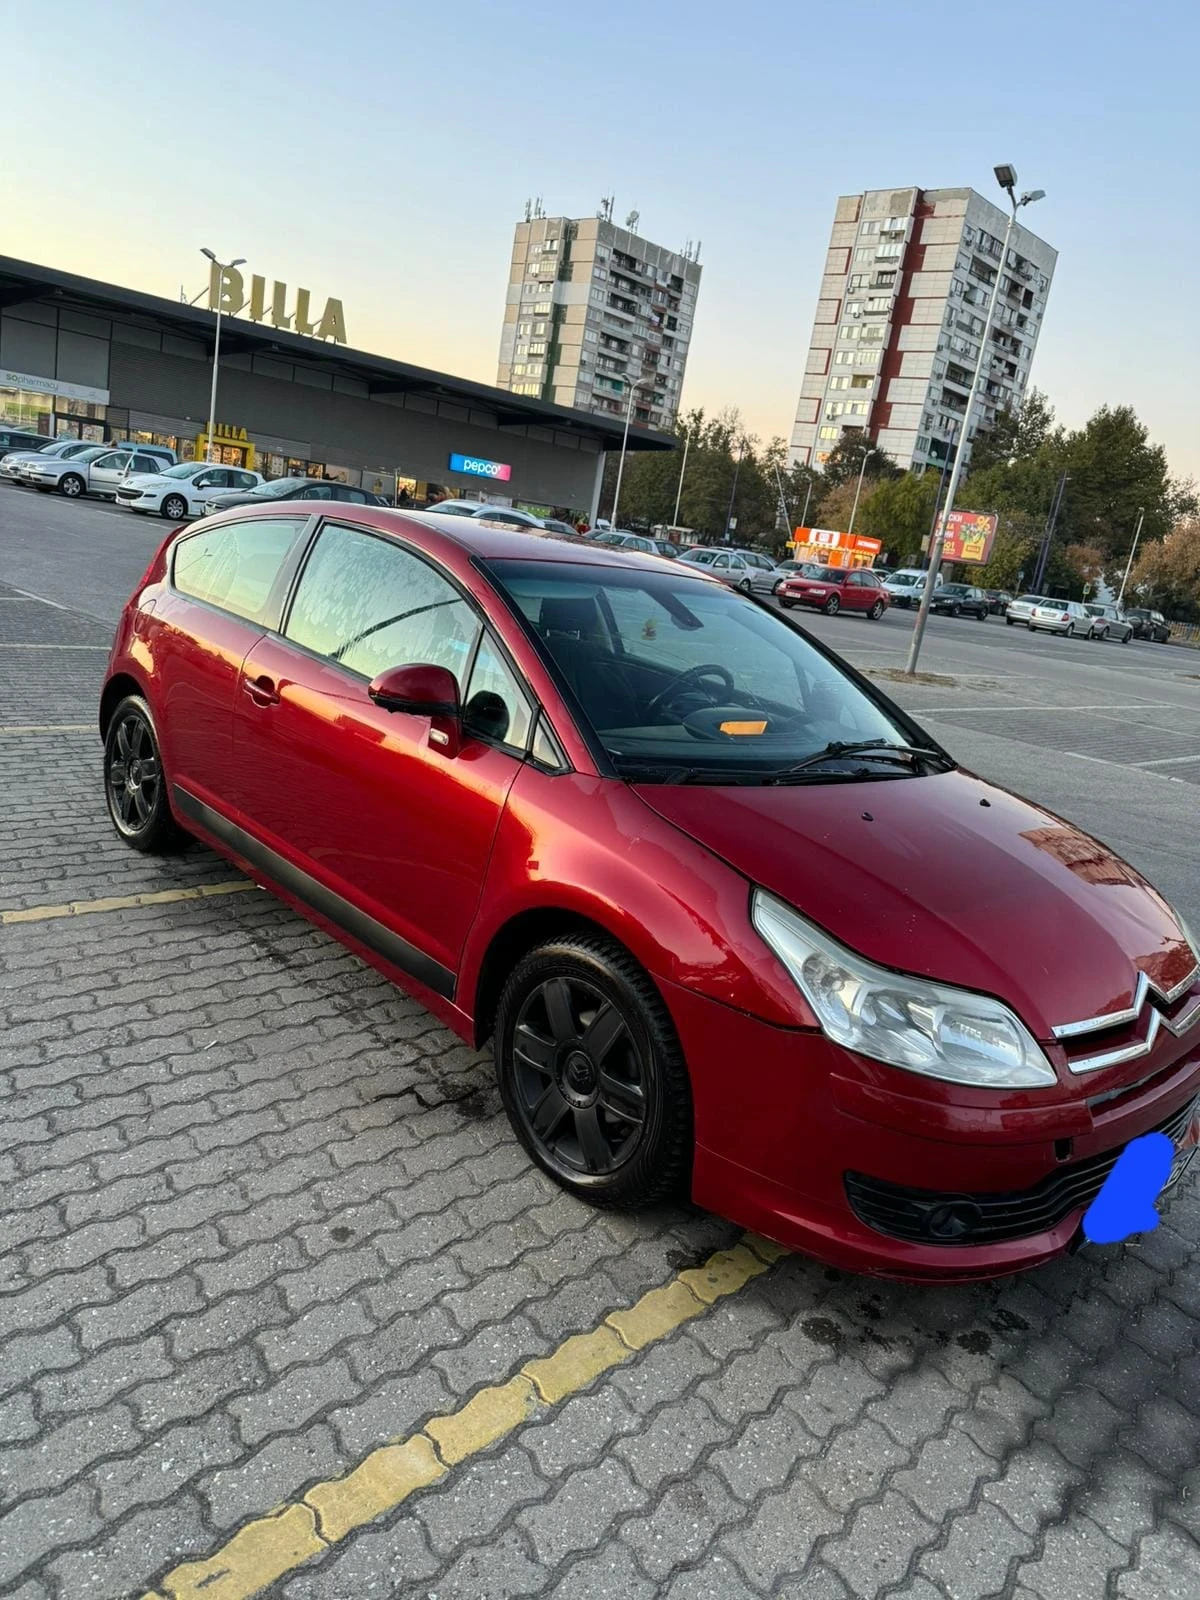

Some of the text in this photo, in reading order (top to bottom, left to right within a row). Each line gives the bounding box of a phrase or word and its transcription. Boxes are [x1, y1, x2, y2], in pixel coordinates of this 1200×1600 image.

[208, 262, 347, 344] BILLA
[6, 373, 59, 391] sopharmacy
[206, 421, 248, 440] BILLA
[463, 459, 500, 475] pepco
[938, 511, 963, 523] НСКИ
